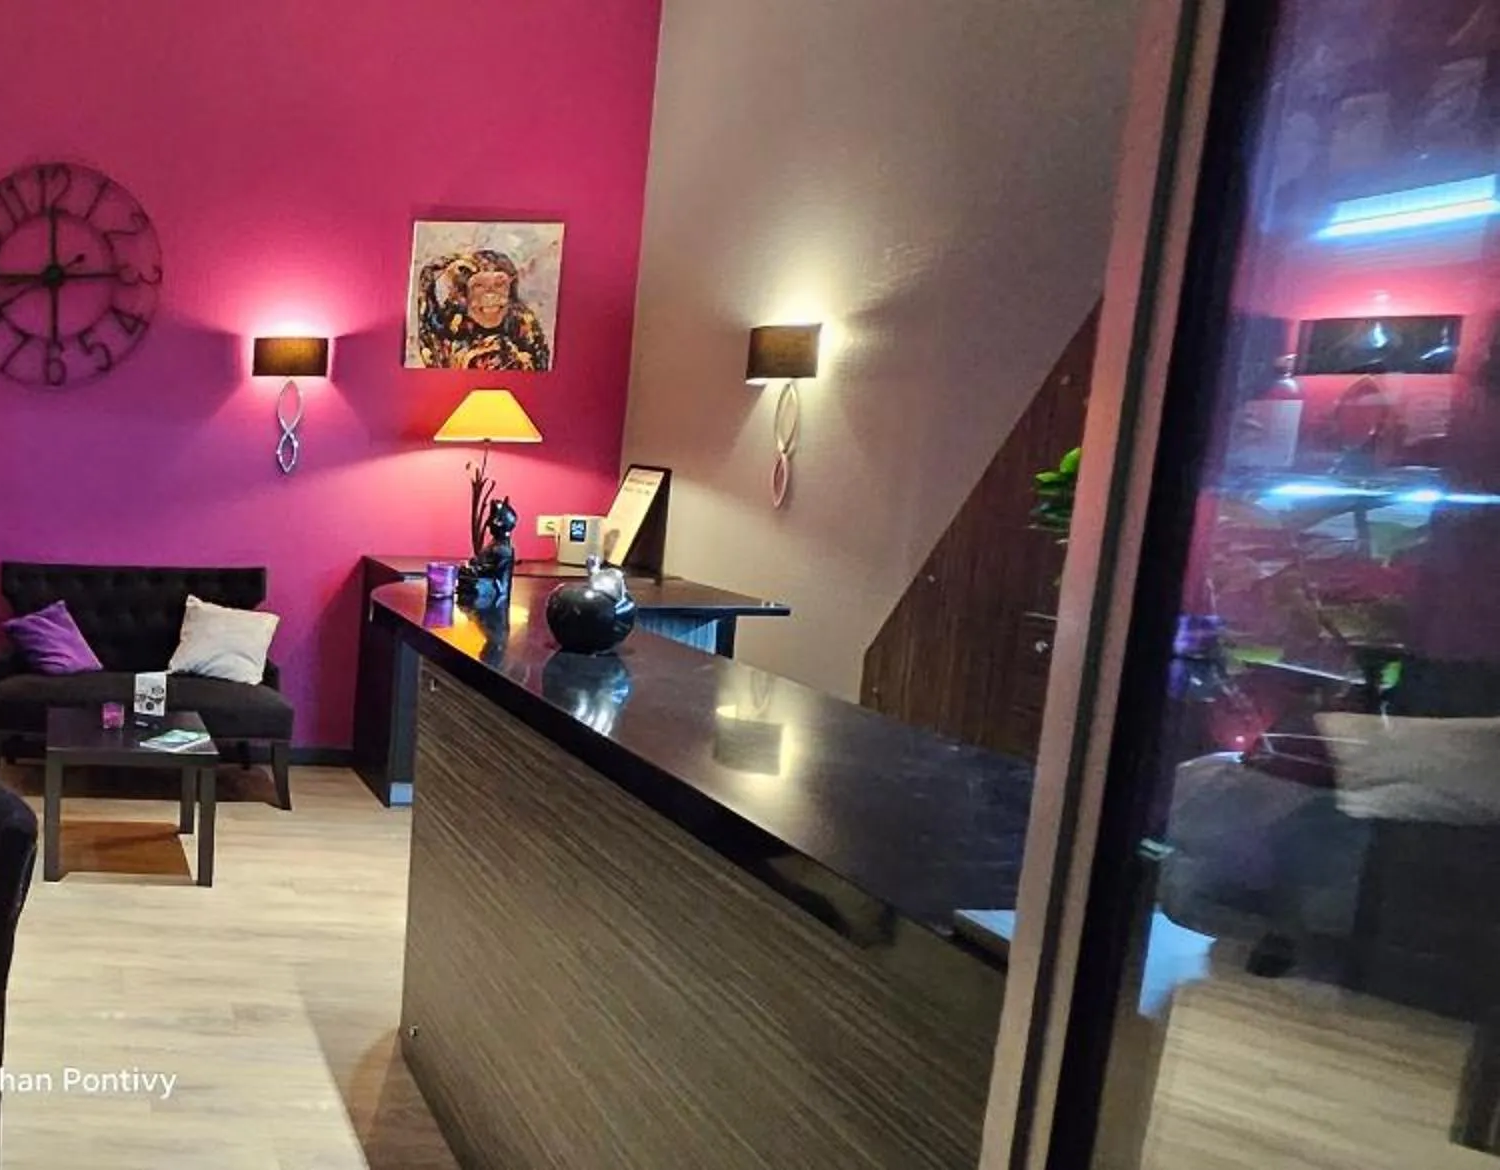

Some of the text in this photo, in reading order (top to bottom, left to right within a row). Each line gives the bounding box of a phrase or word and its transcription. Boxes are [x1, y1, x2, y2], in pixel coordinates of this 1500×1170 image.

[36, 163, 70, 214] 12
[102, 211, 150, 252] 2
[111, 263, 162, 287] 3
[110, 304, 150, 336] 4
[0, 326, 32, 373] 7
[44, 337, 66, 387] 6
[77, 326, 112, 372] 5
